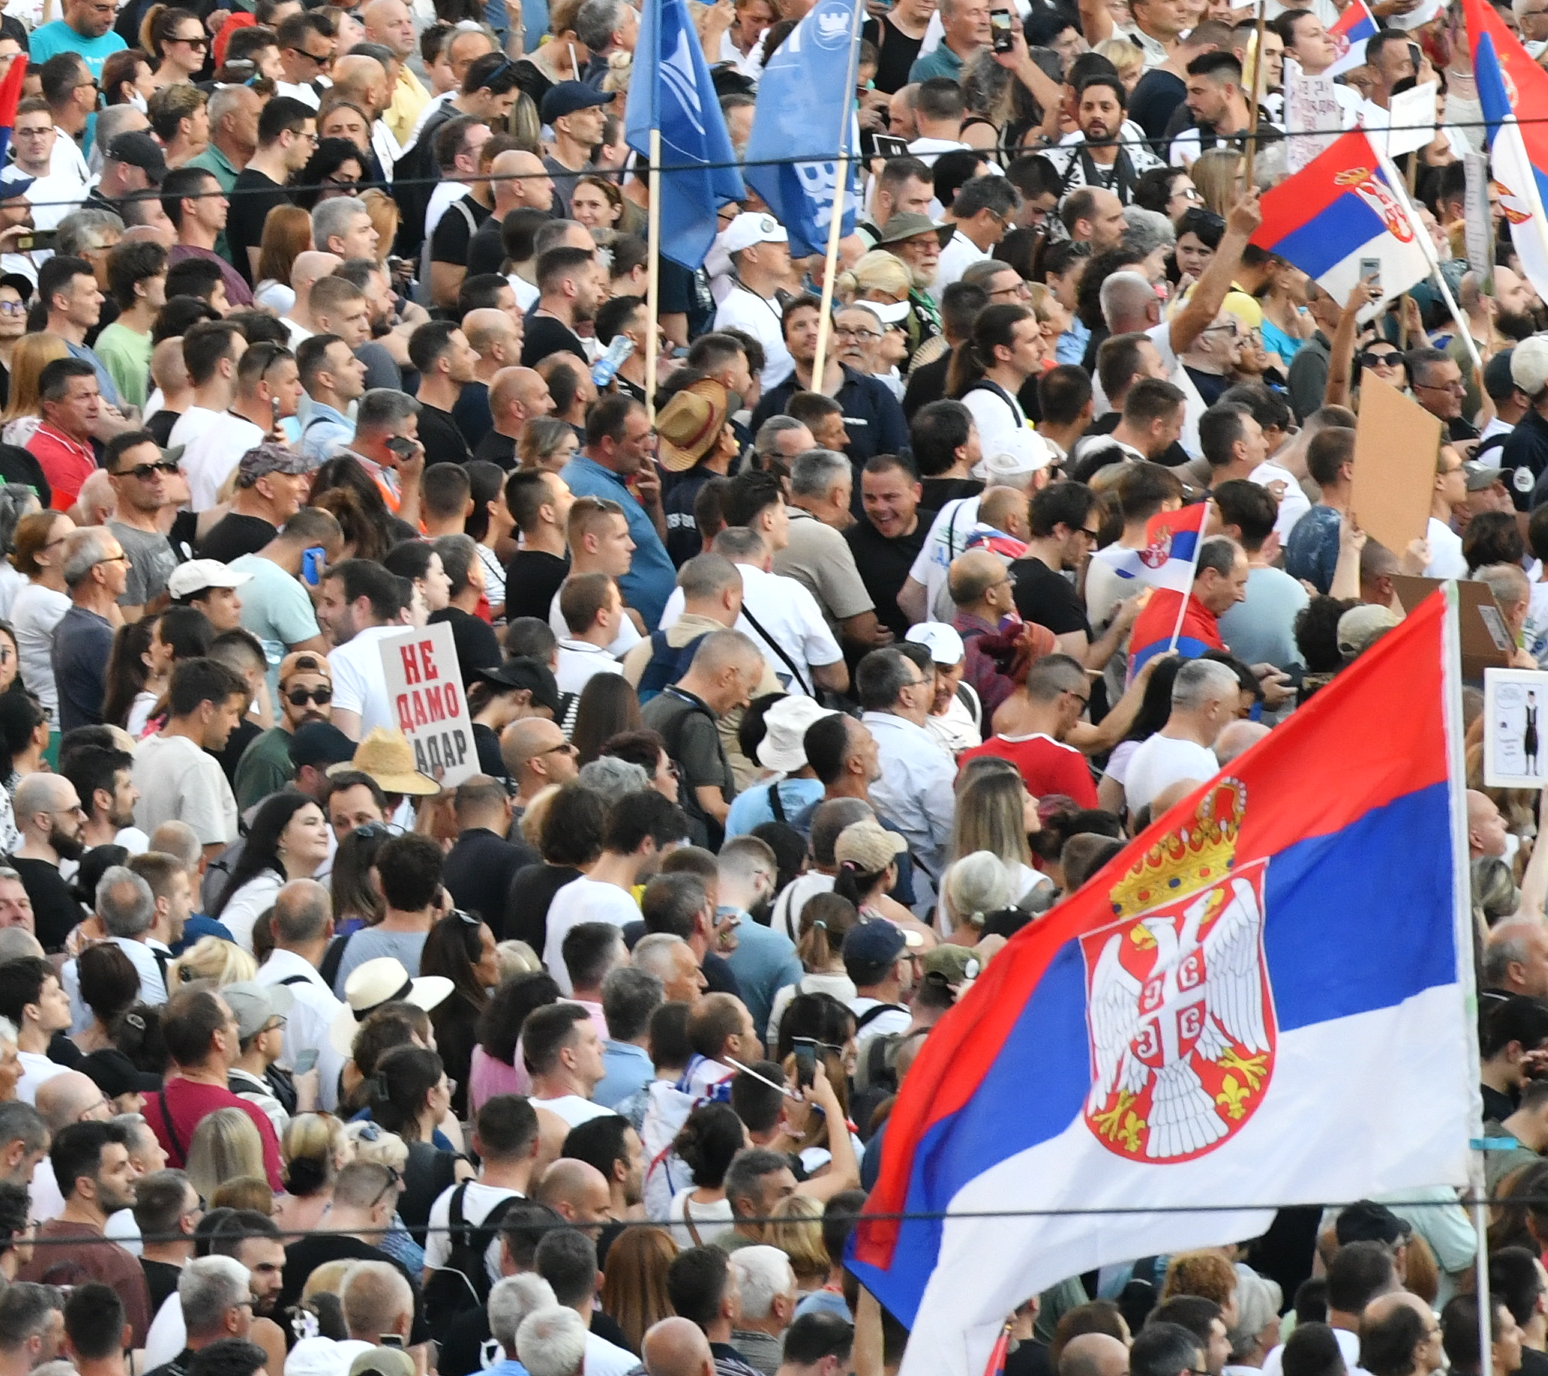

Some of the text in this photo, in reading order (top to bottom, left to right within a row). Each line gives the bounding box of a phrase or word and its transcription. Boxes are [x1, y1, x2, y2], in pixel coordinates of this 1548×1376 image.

[399, 639, 439, 686] НЕ
[396, 681, 460, 735] ДАМО
[413, 729, 468, 778] АДАР
